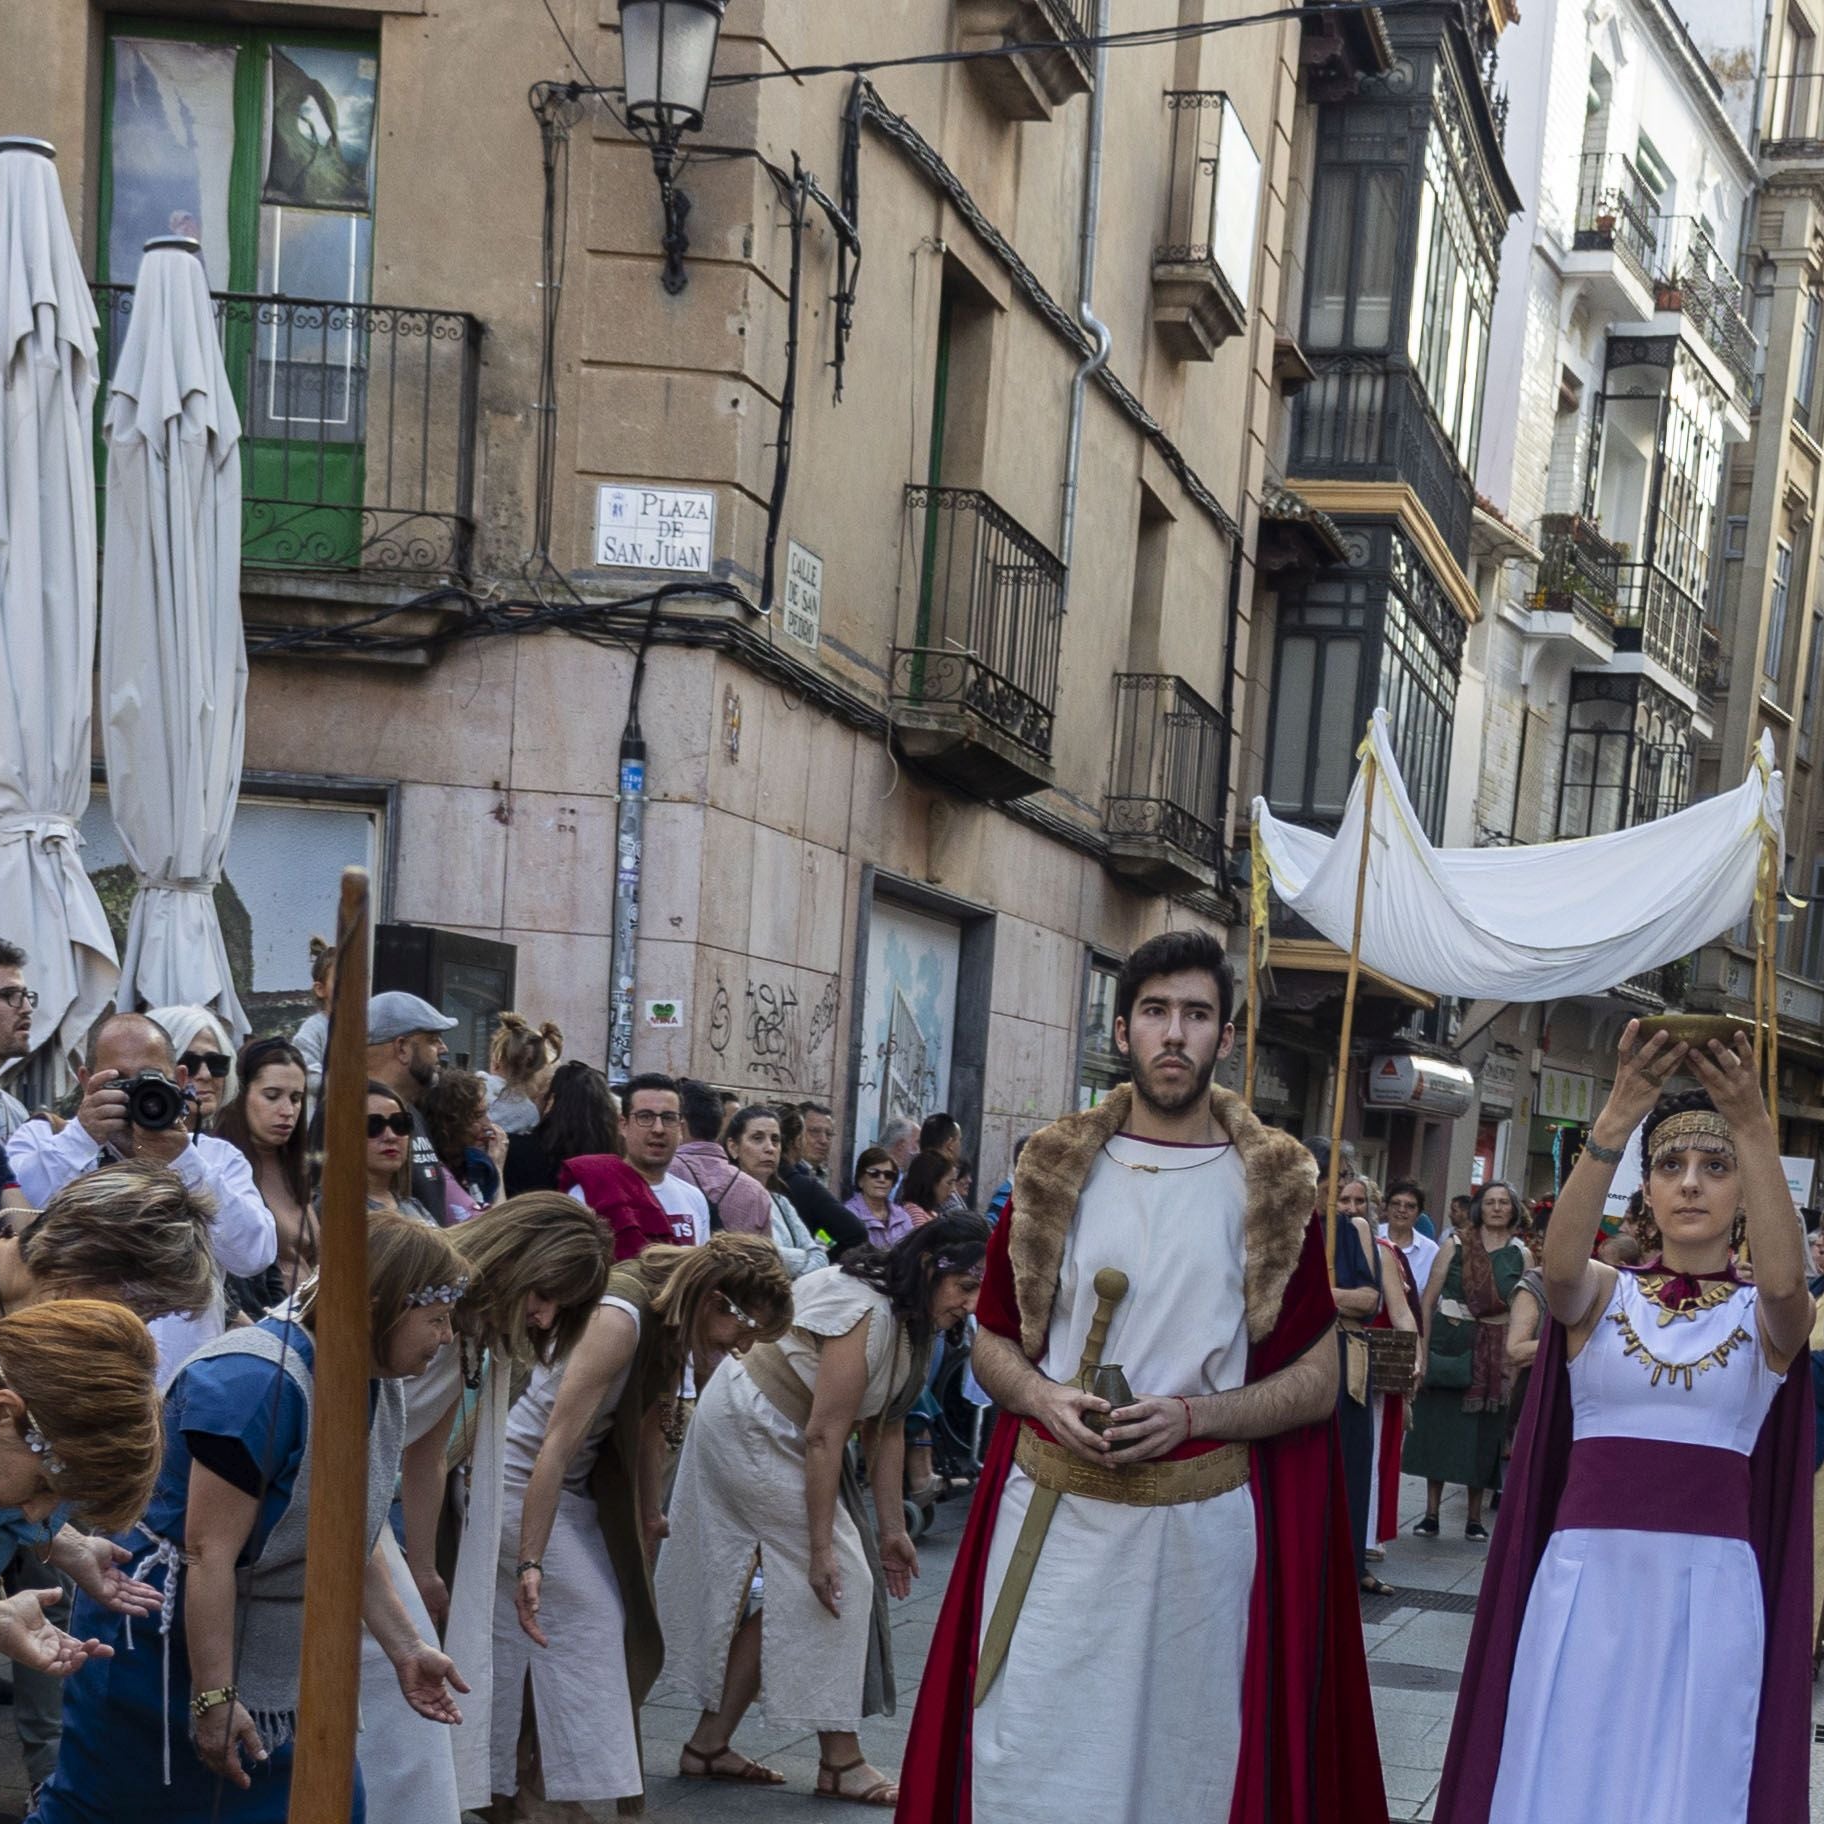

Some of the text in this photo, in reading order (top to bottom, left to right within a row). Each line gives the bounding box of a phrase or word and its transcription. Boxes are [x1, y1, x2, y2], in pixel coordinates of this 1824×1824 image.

[640, 492, 709, 520] PLAZA
[658, 520, 684, 538] DE
[604, 536, 702, 568] SAN JUAN
[791, 552, 817, 588] CALLE
[788, 580, 818, 617] DE SAN
[788, 610, 814, 645] PEDRO
